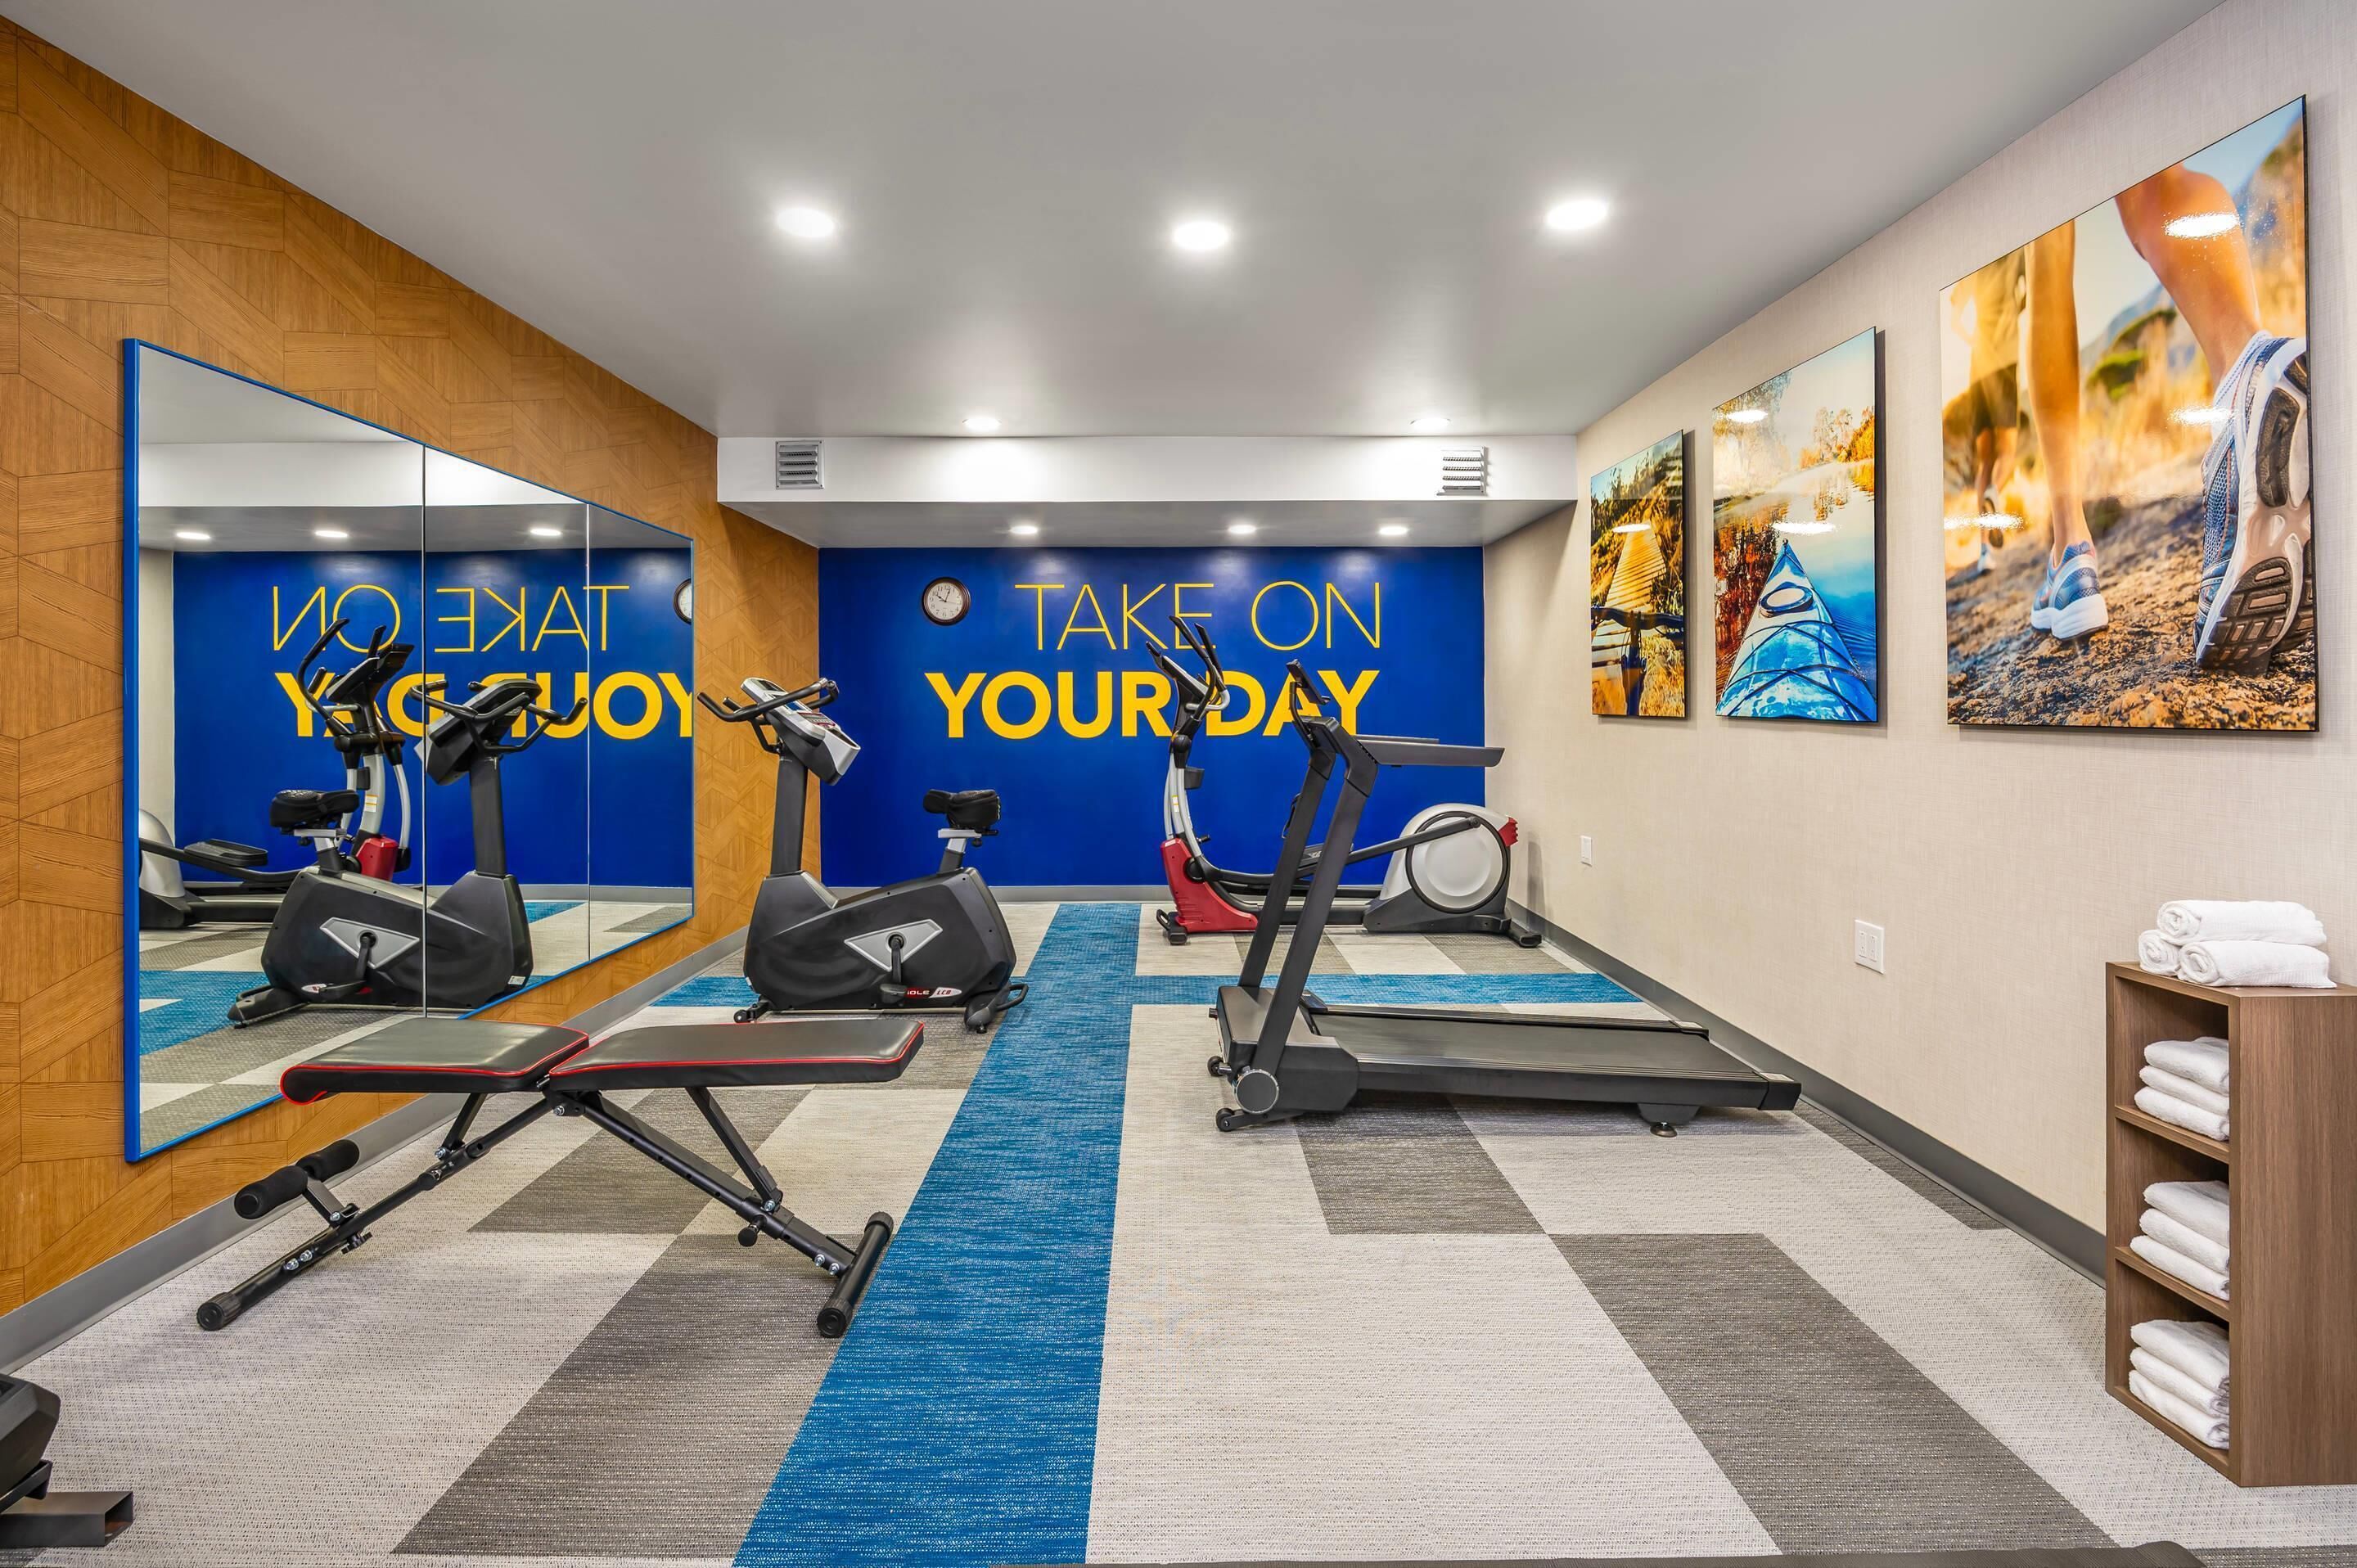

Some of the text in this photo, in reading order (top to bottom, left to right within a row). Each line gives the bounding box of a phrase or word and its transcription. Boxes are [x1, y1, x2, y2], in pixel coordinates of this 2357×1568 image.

[1014, 580, 1381, 651] TAKE ON
[925, 669, 1381, 740] YOUR DAY
